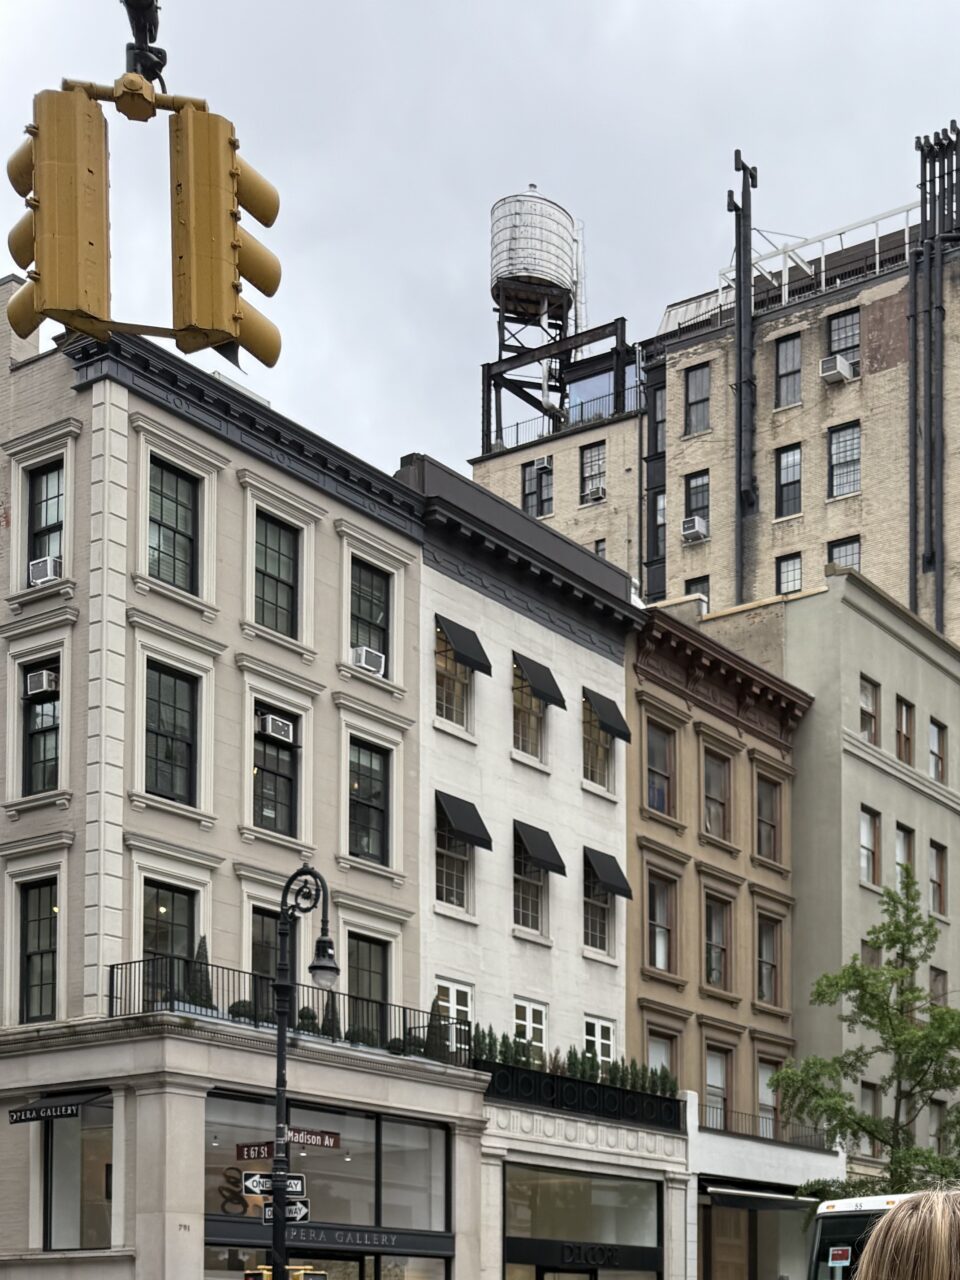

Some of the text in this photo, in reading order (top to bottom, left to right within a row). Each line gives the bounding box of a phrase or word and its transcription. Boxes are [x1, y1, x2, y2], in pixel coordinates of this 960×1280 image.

[40, 1106, 78, 1117] GALLERY
[287, 1130, 335, 1147] Madison Av
[243, 1146, 268, 1159] E 67 St
[252, 1180, 272, 1189] ONE
[288, 1206, 304, 1215] WAY
[285, 1228, 398, 1246] PERA GALLERY
